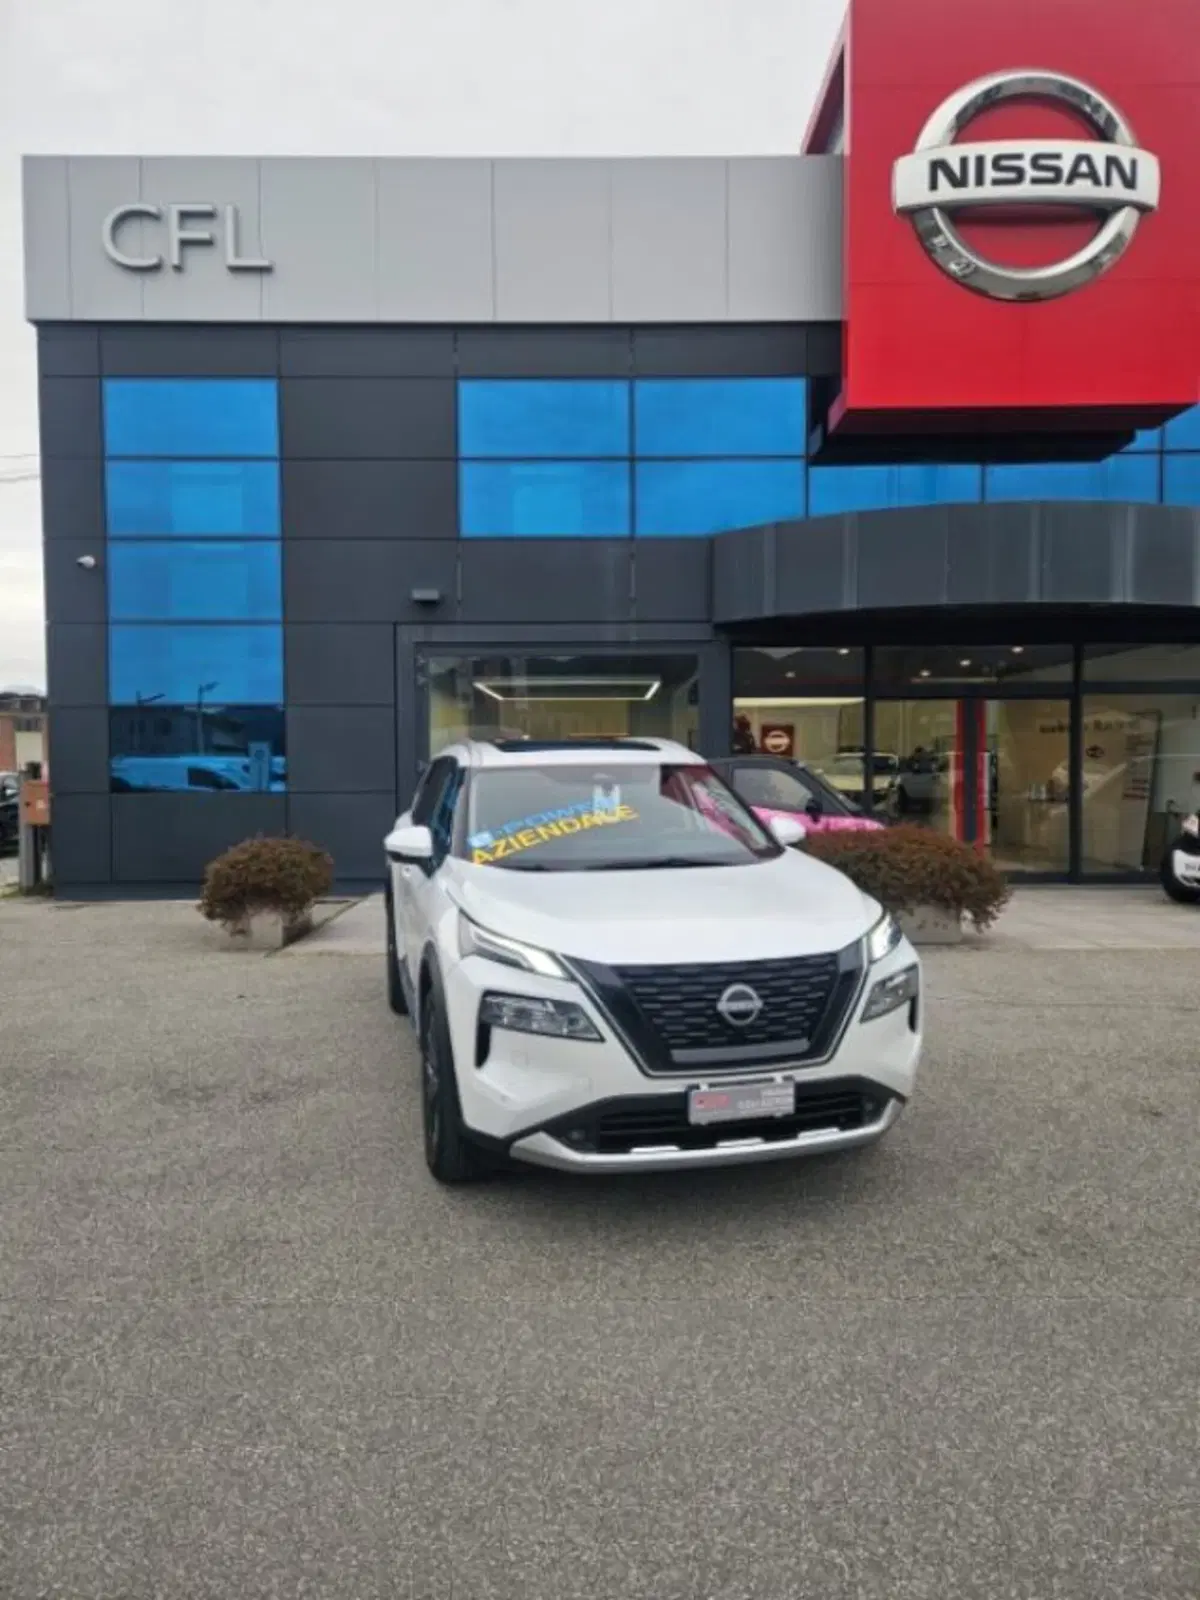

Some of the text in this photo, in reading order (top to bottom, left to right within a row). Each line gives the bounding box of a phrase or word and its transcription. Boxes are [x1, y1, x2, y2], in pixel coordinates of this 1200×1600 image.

[928, 153, 1137, 191] NISSAN
[102, 203, 272, 270] CFL
[472, 803, 639, 865] AZIENDALE
